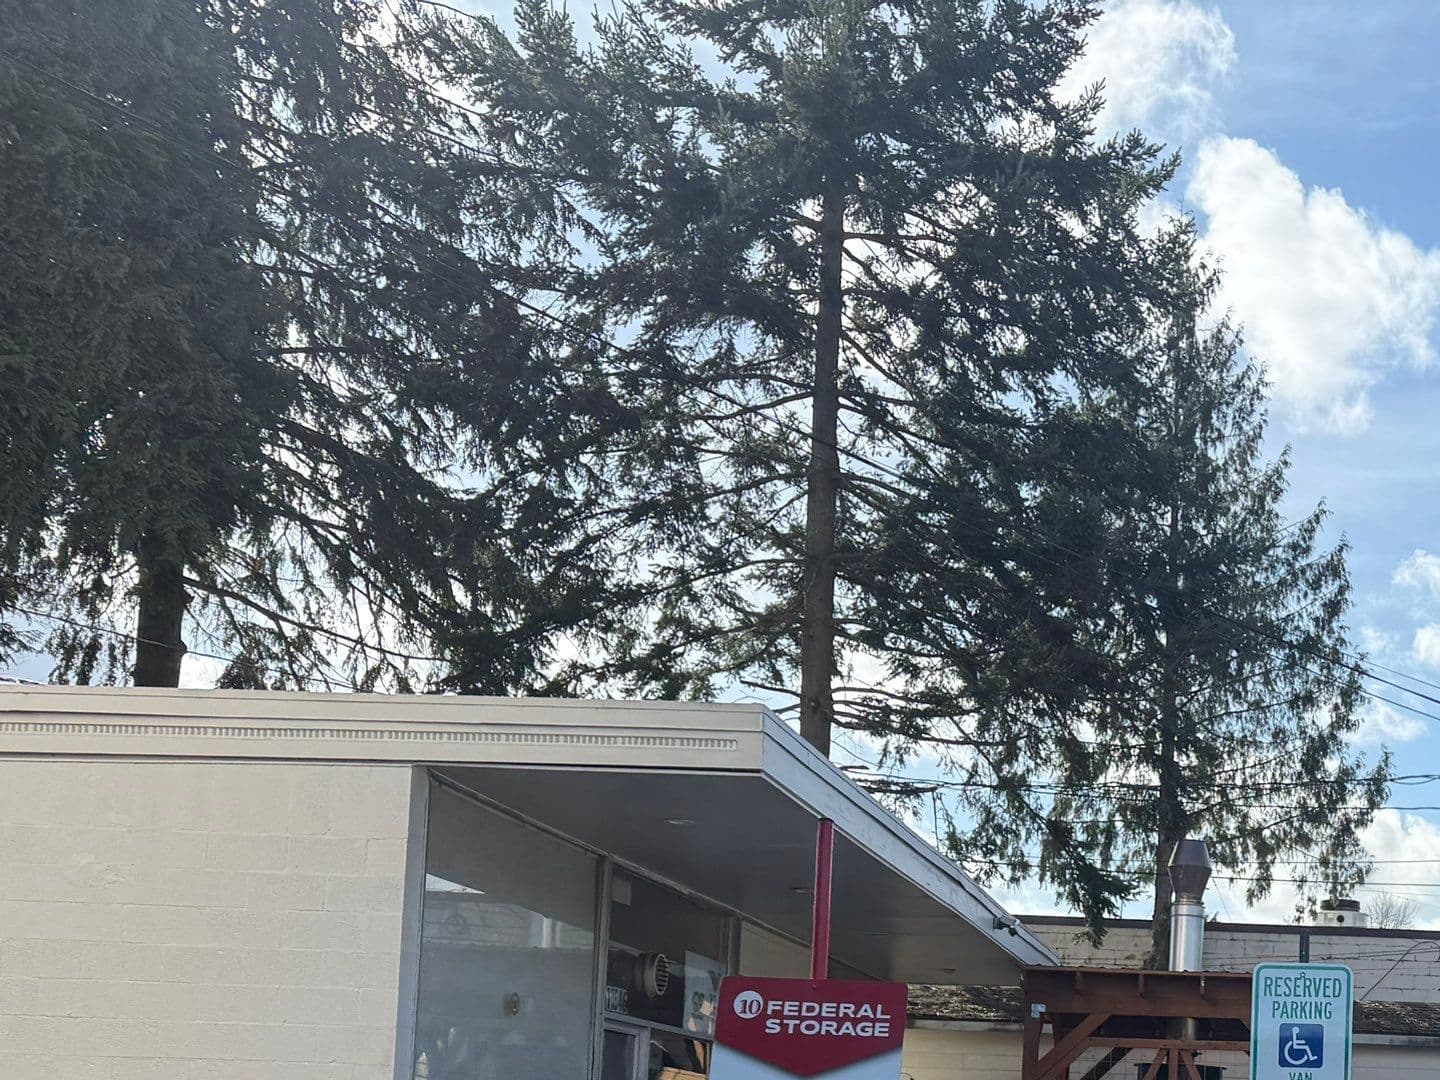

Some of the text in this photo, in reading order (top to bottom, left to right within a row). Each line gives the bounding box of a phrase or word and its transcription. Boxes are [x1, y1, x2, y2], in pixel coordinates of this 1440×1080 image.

[1263, 976, 1343, 998] RESERVED
[738, 998, 762, 1015] 10
[767, 1000, 891, 1019] FEDERAL
[1272, 1000, 1333, 1020] PARKING
[765, 1019, 890, 1037] STORAGE
